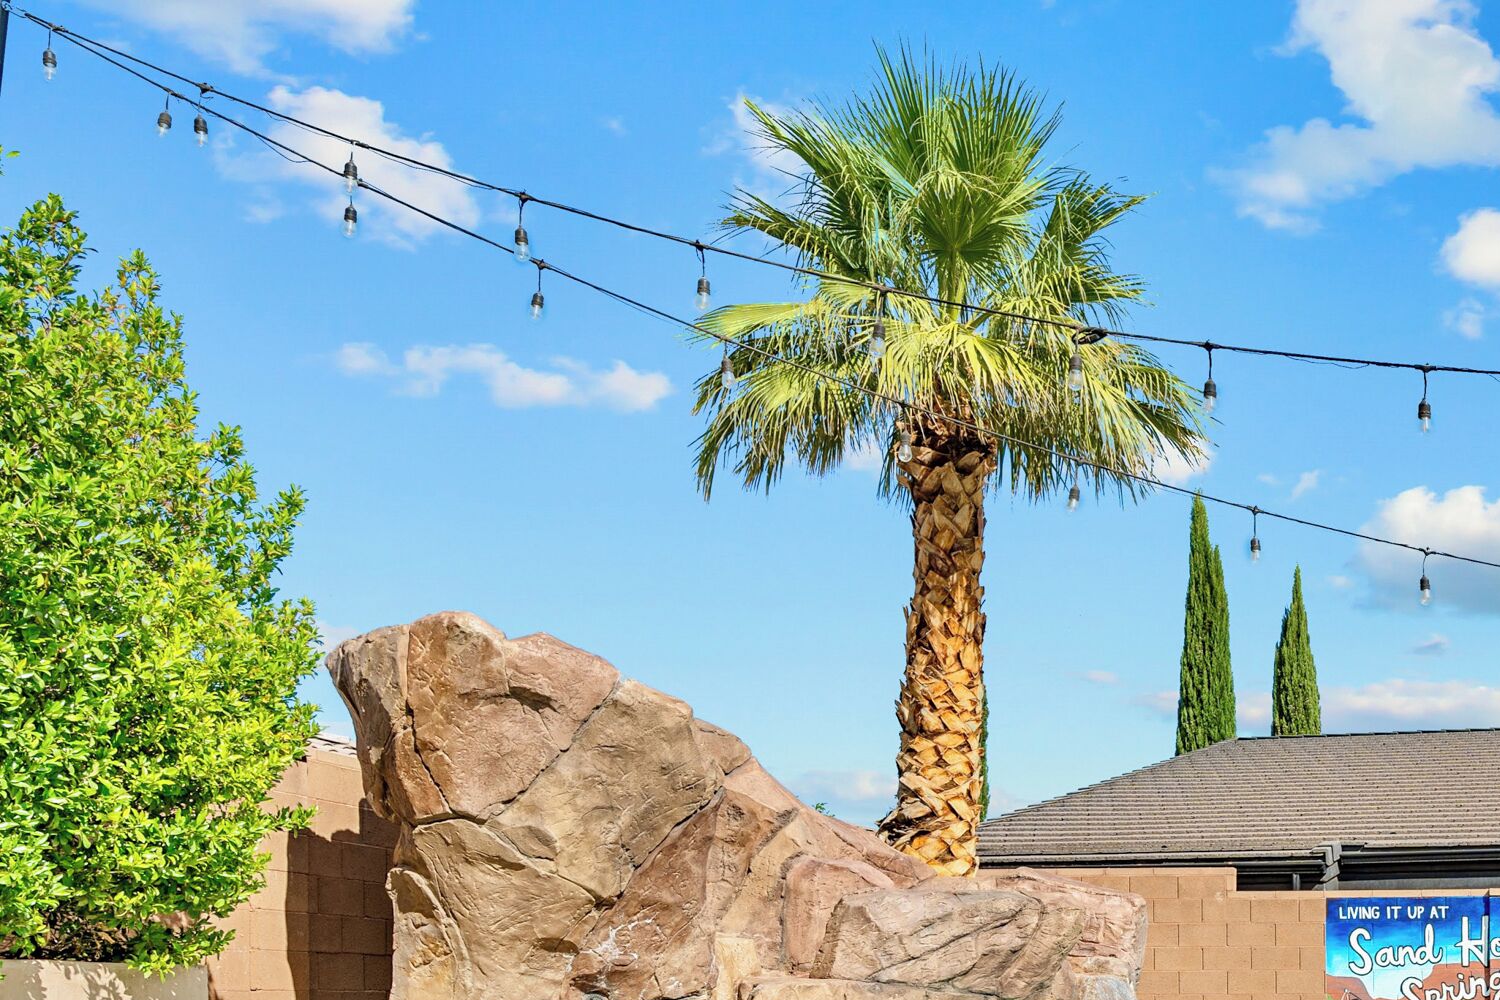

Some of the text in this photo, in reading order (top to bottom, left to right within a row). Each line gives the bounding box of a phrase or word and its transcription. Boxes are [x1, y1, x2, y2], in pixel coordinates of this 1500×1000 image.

[1338, 905, 1450, 920] LIVING IT UP AT
[1348, 923, 1443, 976] Sand
